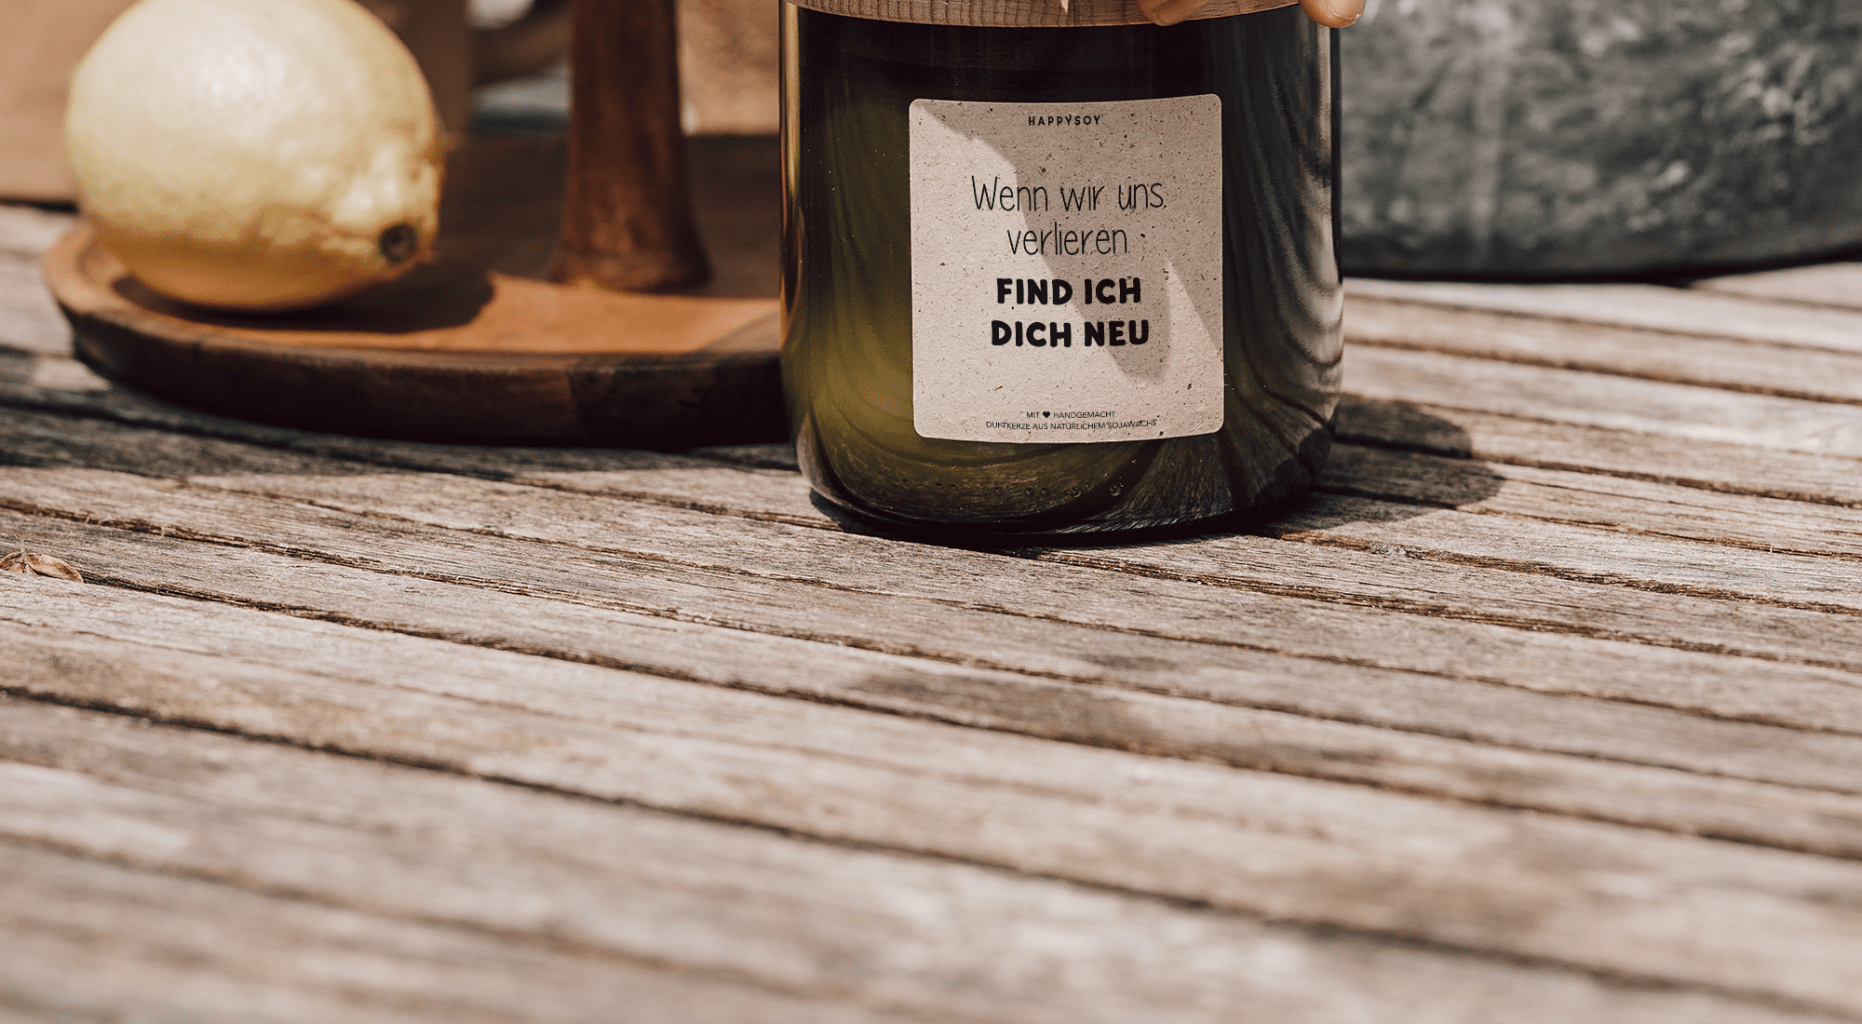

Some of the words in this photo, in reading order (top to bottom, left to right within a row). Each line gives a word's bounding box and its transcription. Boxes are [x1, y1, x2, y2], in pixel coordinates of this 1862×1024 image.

[1028, 114, 1101, 126] HAPPYSOY
[971, 175, 1049, 212] Wenn
[1060, 183, 1106, 212] wir
[1007, 221, 1128, 256] verlieren
[996, 277, 1073, 306] FIND
[1084, 277, 1142, 305] ICH
[991, 320, 1072, 348] DICH
[1084, 319, 1150, 347] NEU
[1026, 411, 1040, 419] MIT
[1053, 410, 1116, 419] HANDGEMACHT
[1032, 422, 1049, 430] AUS
[1050, 421, 1106, 430] NATÜRLICHEM
